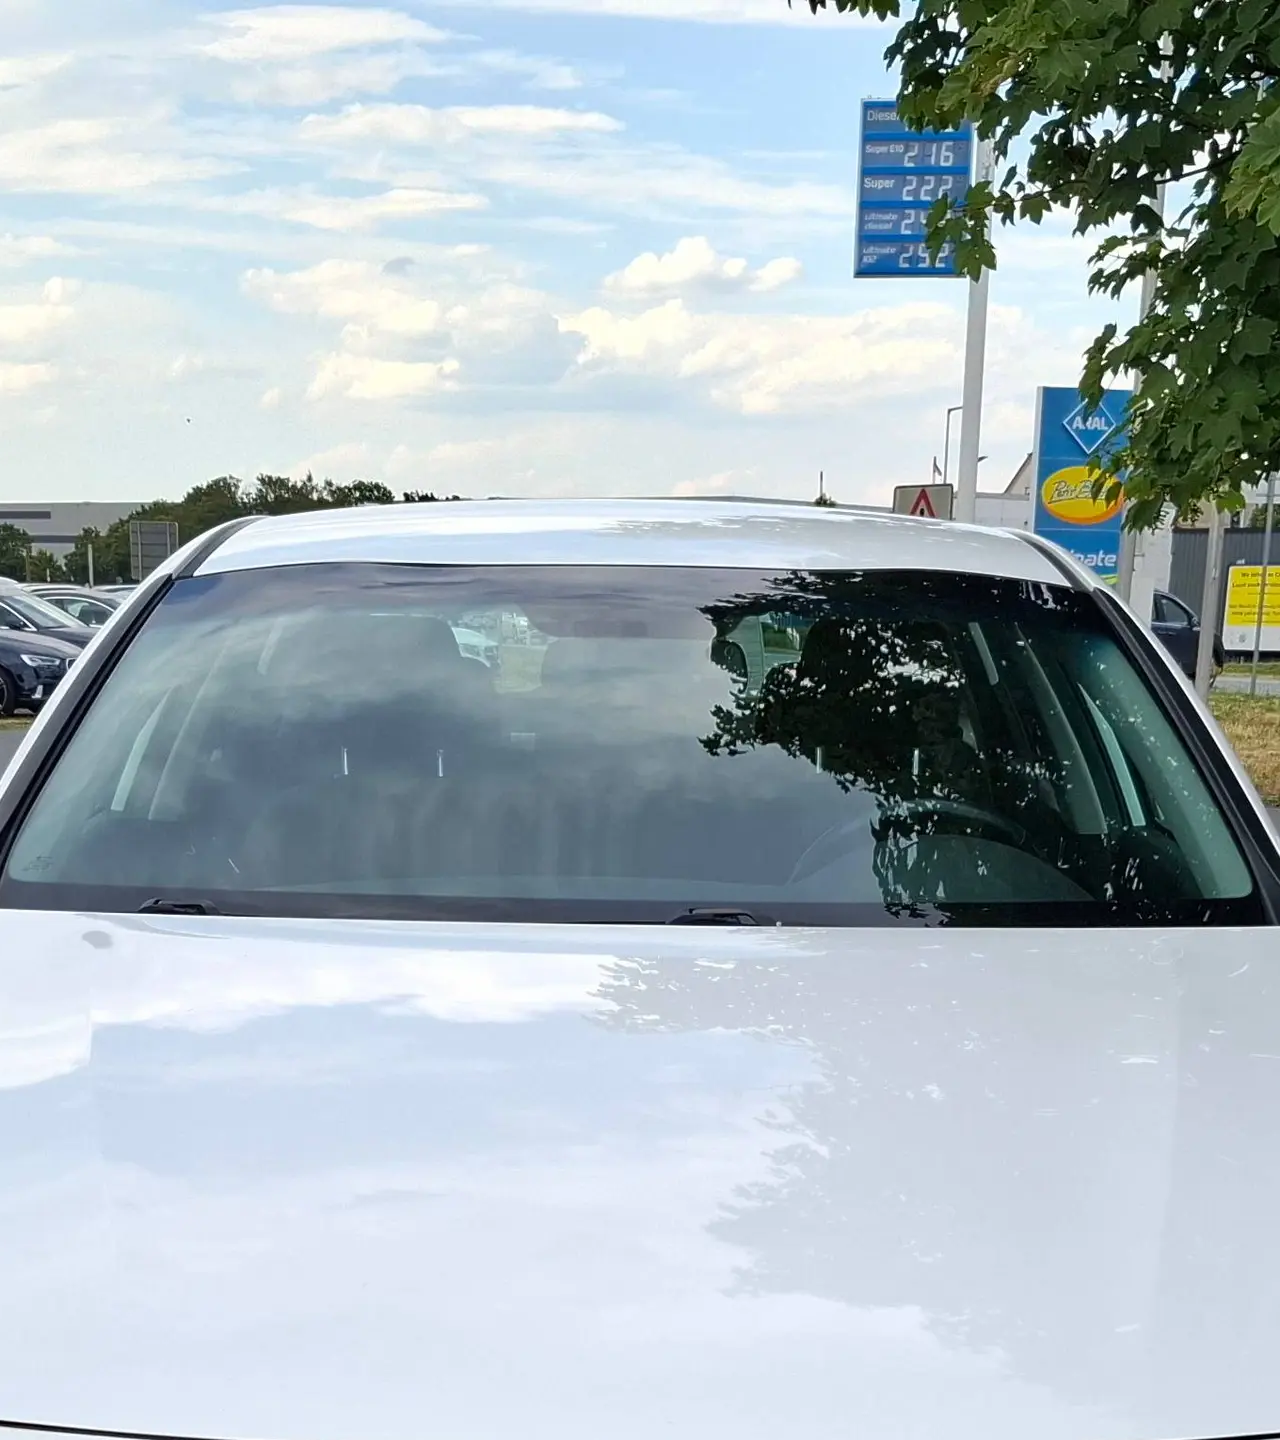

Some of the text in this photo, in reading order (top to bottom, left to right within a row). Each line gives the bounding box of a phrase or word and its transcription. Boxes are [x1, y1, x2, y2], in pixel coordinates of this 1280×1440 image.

[865, 141, 954, 167] Super E10 216
[864, 175, 953, 201] Super 222
